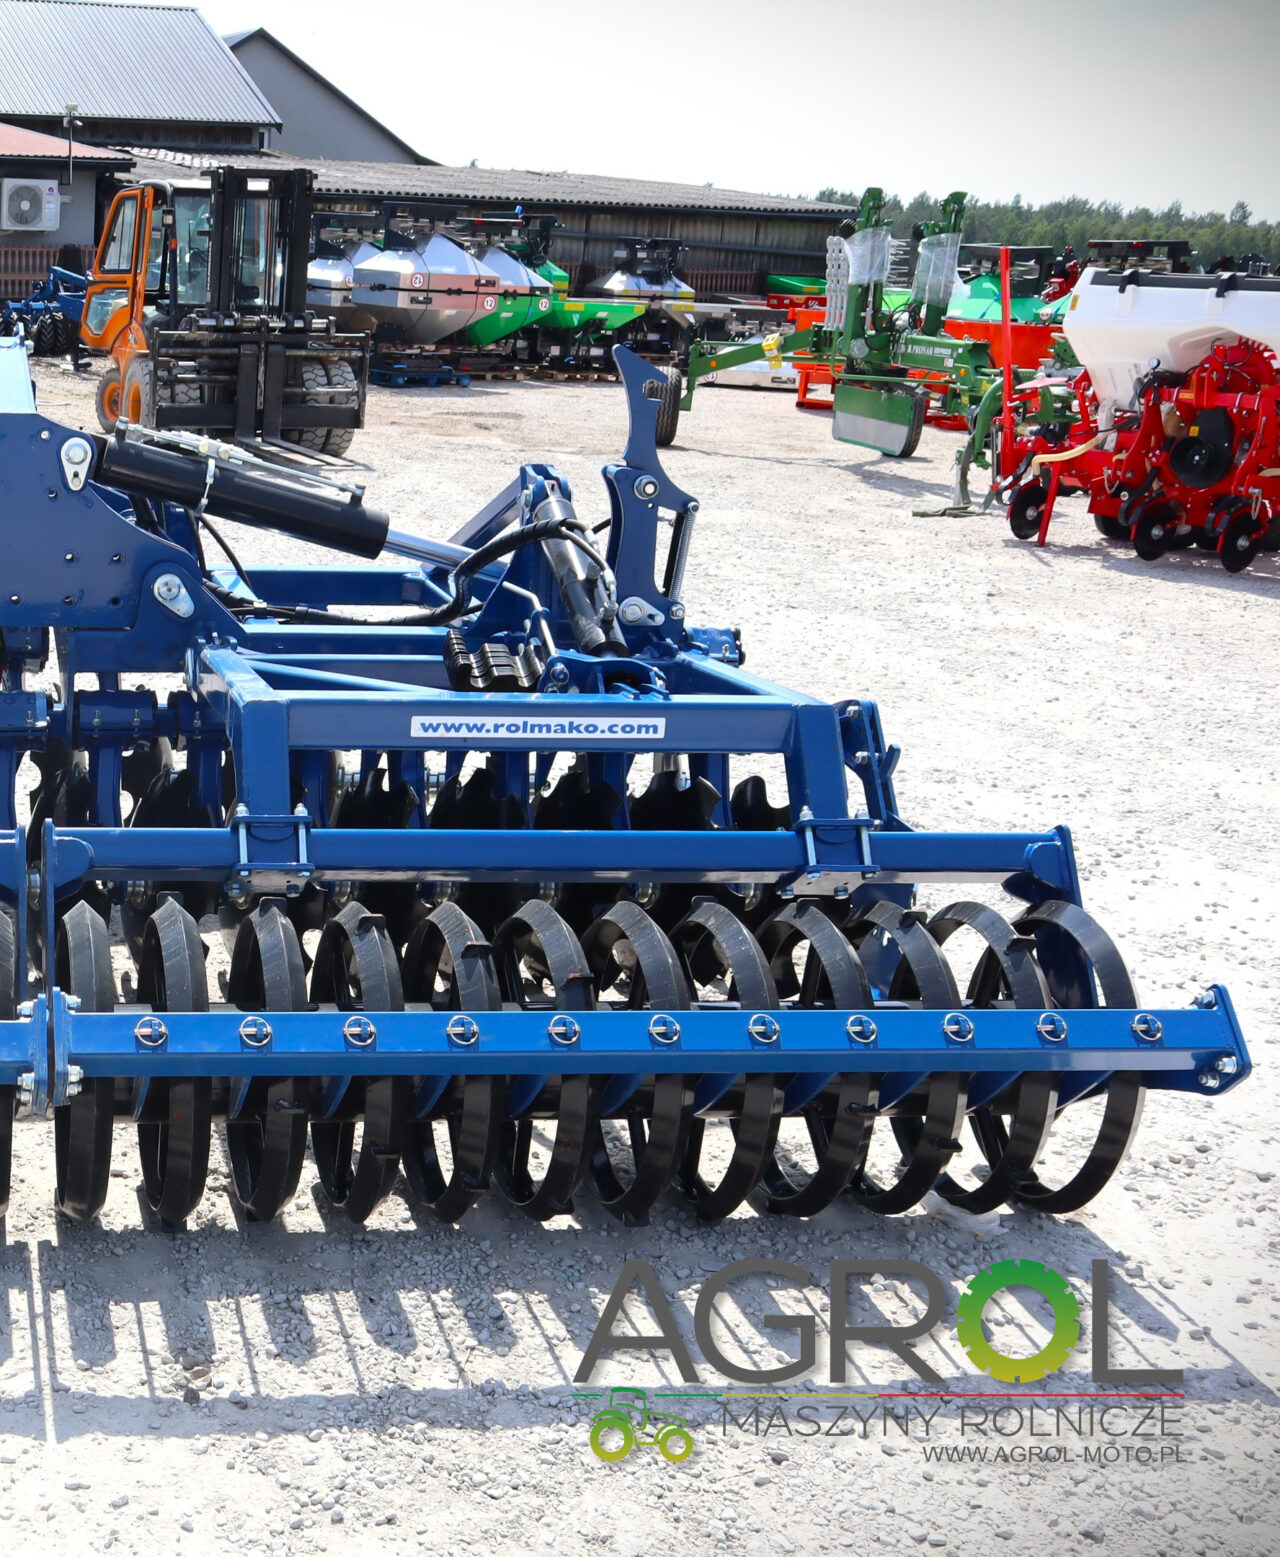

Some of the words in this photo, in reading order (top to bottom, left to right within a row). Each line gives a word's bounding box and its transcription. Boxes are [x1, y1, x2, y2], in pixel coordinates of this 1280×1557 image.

[486, 299, 494, 307] 12
[540, 300, 548, 308] 12
[420, 720, 659, 735] www.rolmako.com
